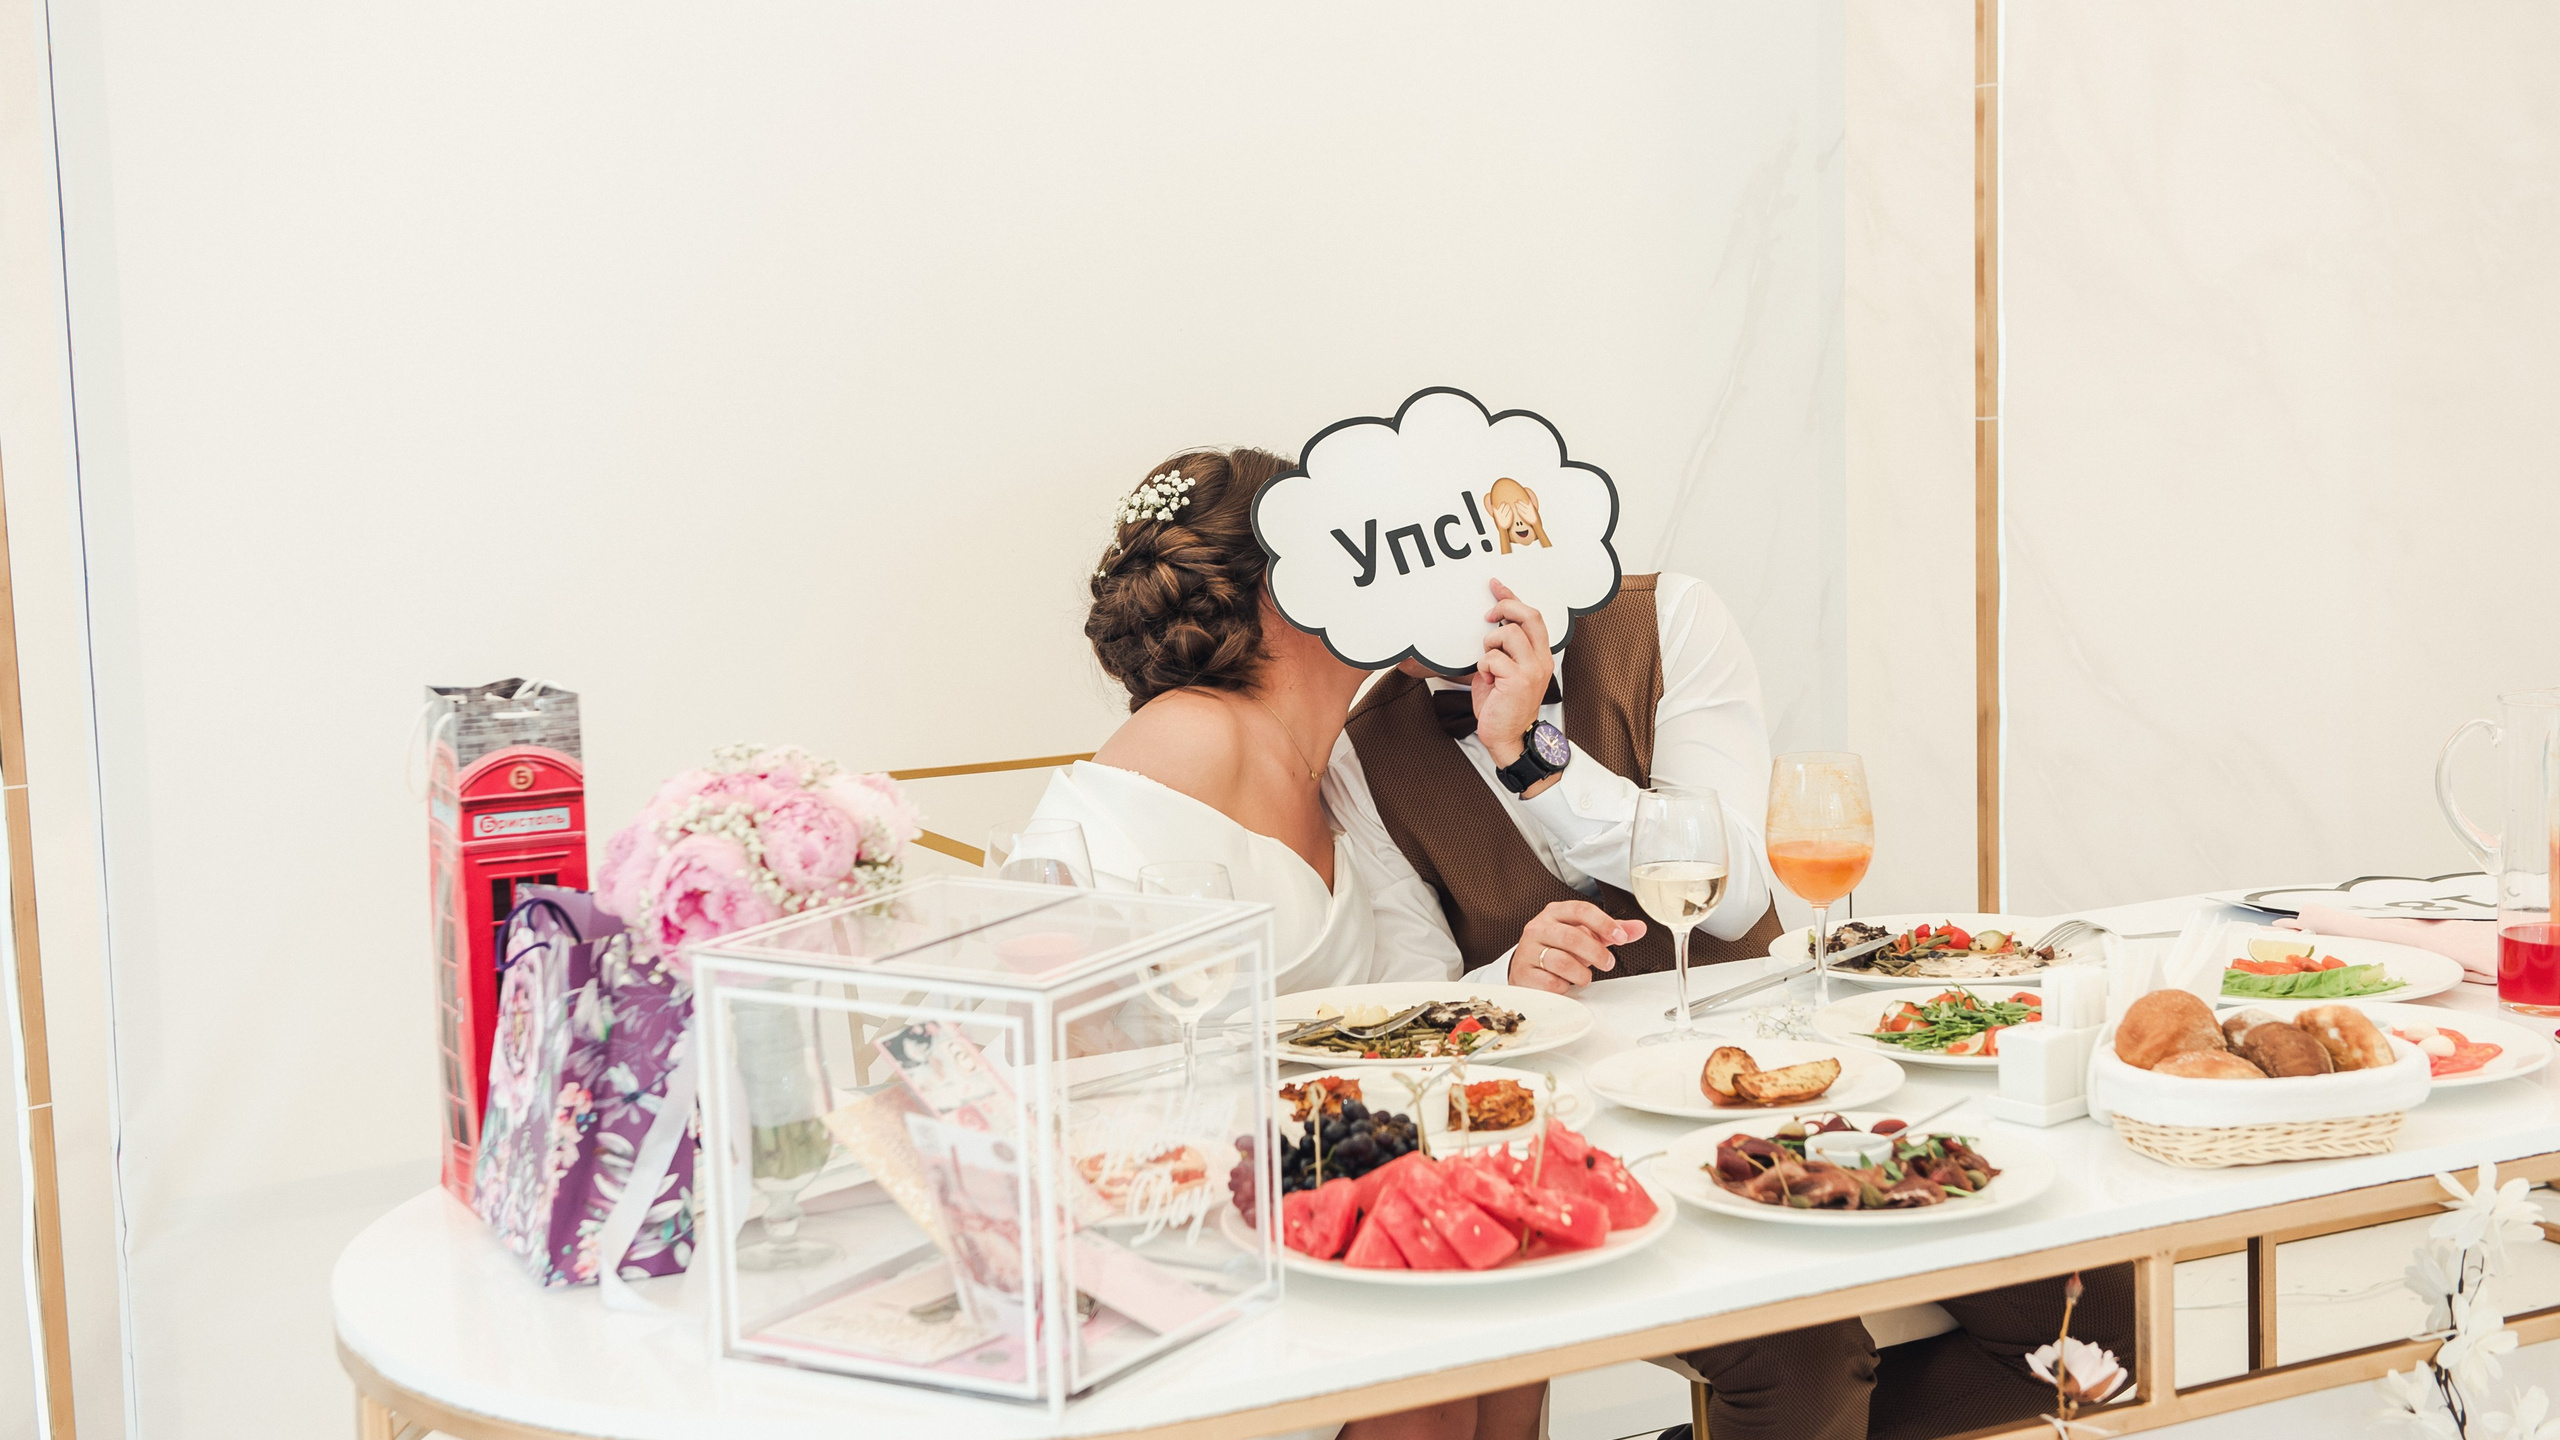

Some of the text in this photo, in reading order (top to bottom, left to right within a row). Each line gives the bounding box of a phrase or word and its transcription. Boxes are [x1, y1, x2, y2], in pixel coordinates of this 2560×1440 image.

[1330, 491, 1493, 587] Упс!
[514, 770, 530, 786] Б
[479, 814, 566, 834] Бристоль
[1125, 1164, 1213, 1246] Day
